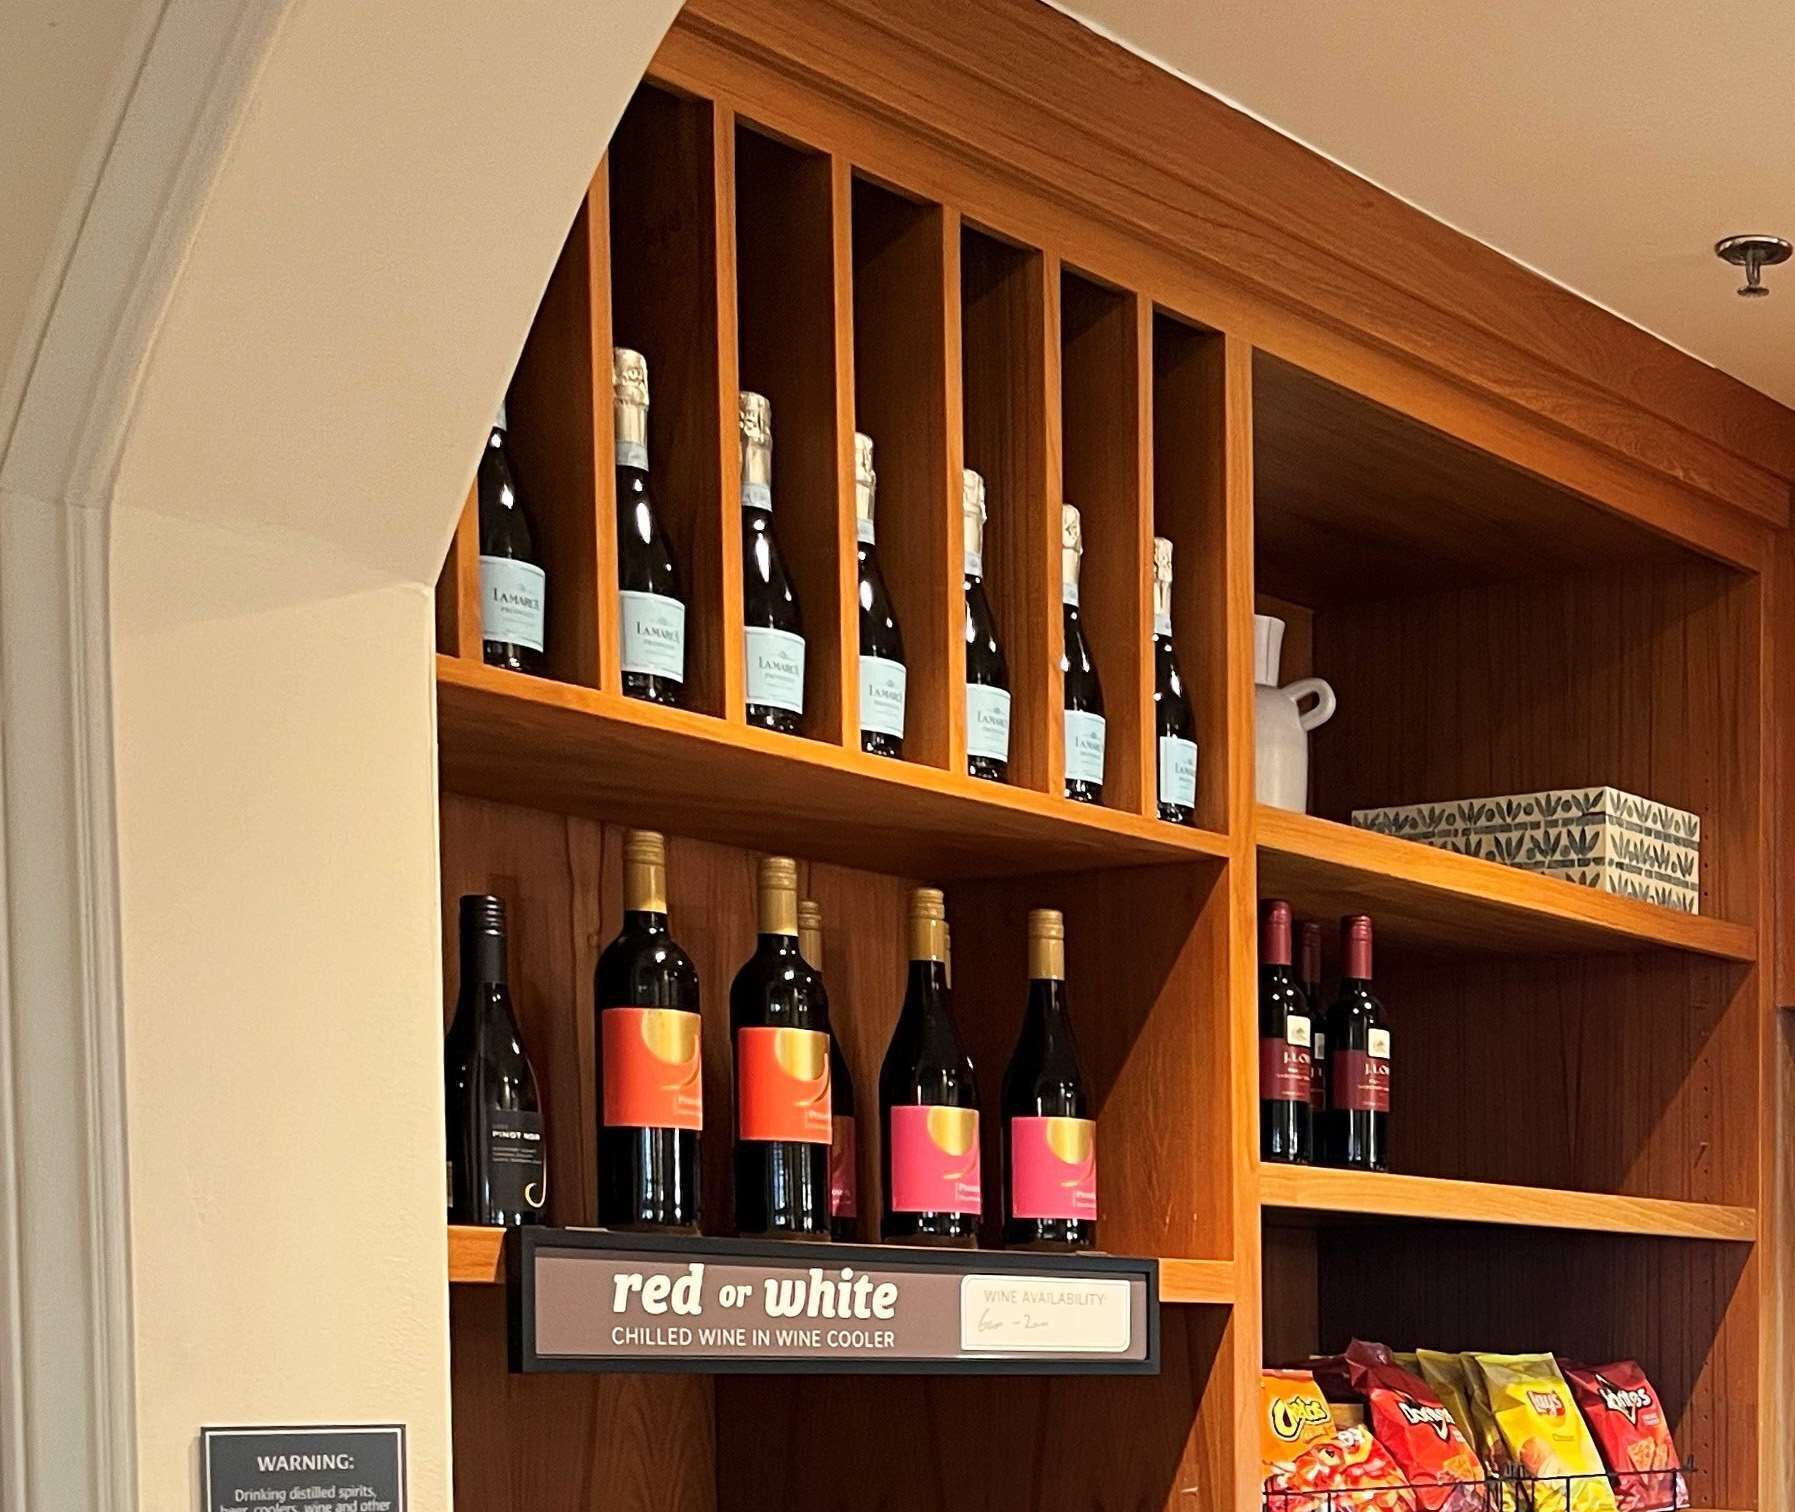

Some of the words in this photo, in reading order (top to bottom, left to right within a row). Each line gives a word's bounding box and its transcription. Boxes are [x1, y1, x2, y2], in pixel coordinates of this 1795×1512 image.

[492, 1130, 521, 1139] PINOT
[612, 1263, 705, 1315] red
[718, 1284, 753, 1308] or
[764, 1267, 898, 1320] white
[984, 1289, 1017, 1304] WINE
[1022, 1291, 1105, 1306] AVAILABILITY
[611, 1326, 692, 1346] CHILLED
[698, 1328, 746, 1347] WINE
[752, 1329, 770, 1347] IN
[775, 1329, 821, 1347] WINE
[827, 1330, 895, 1348] COOLER
[257, 1454, 355, 1472] WARNING:
[234, 1489, 286, 1504] Drinking
[289, 1485, 336, 1500] distilled
[338, 1484, 377, 1499] spirits,
[335, 1501, 358, 1512] and
[360, 1500, 391, 1512] other
